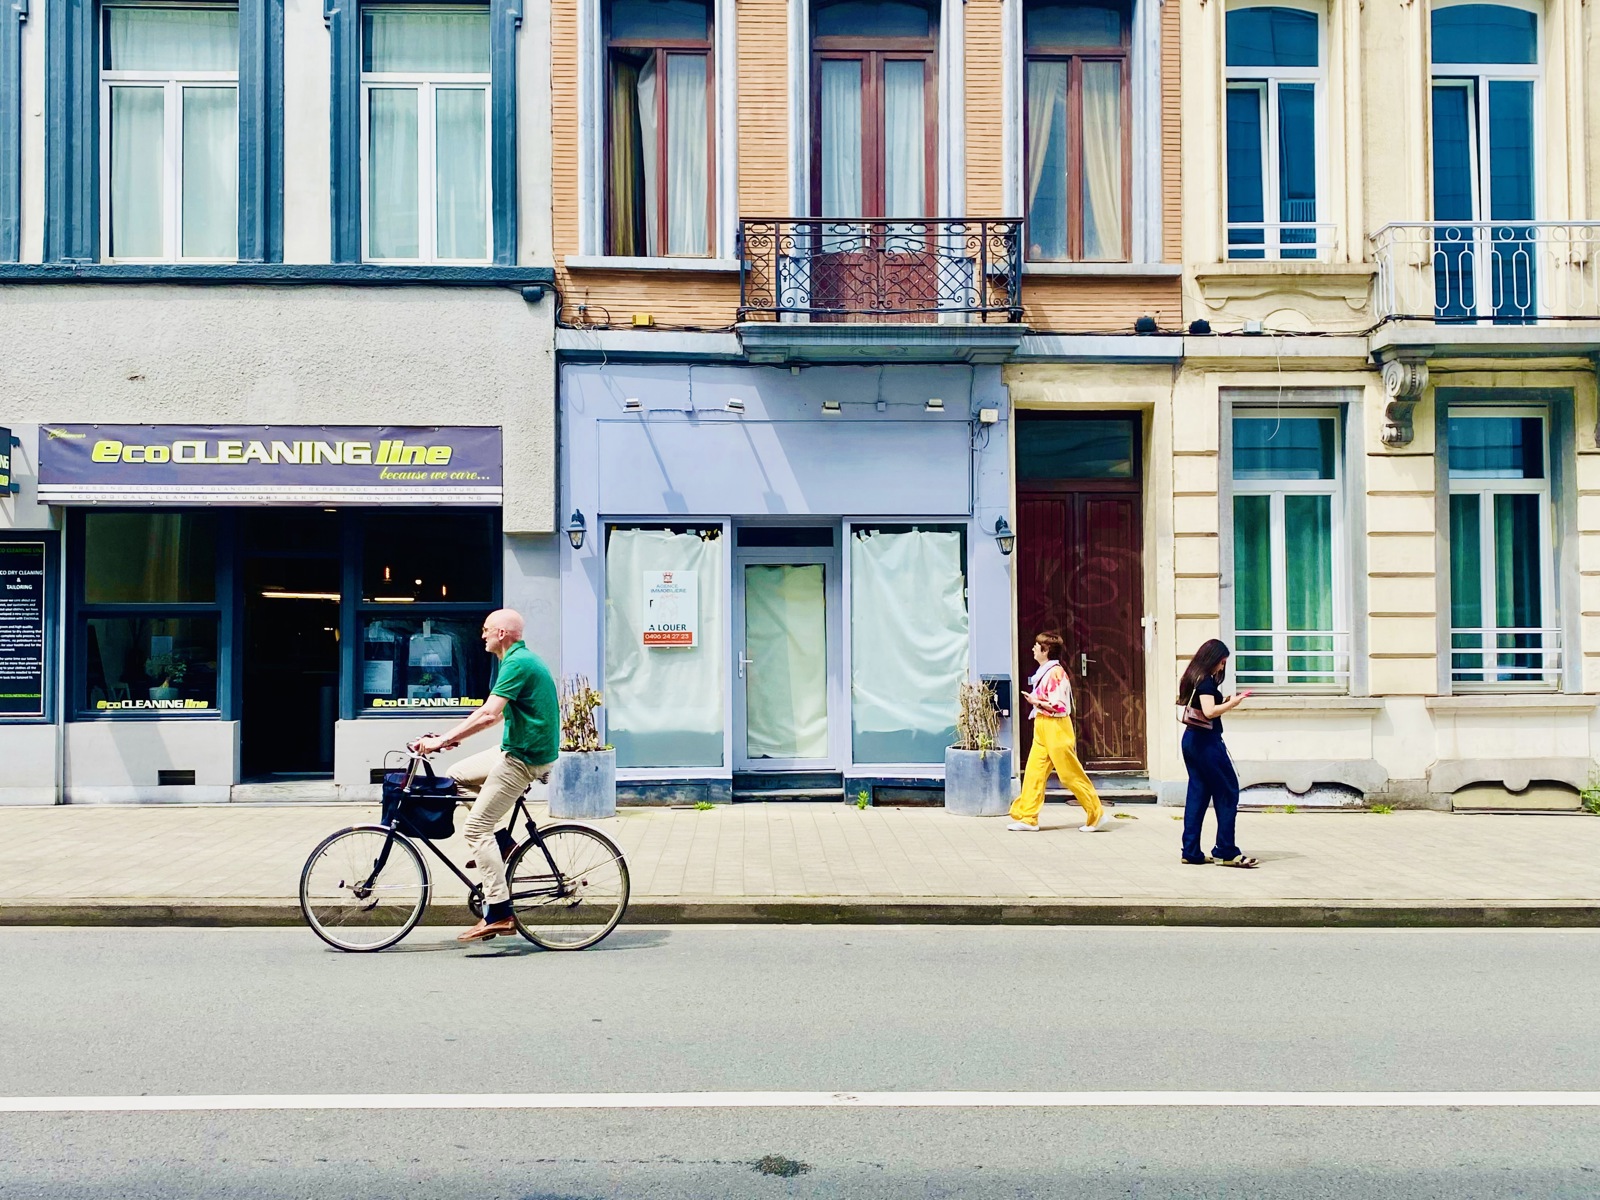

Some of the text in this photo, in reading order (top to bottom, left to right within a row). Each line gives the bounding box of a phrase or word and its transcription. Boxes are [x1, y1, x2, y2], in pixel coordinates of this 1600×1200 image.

[380, 466, 428, 480] because
[430, 471, 448, 480] we
[658, 623, 687, 631] LOUER
